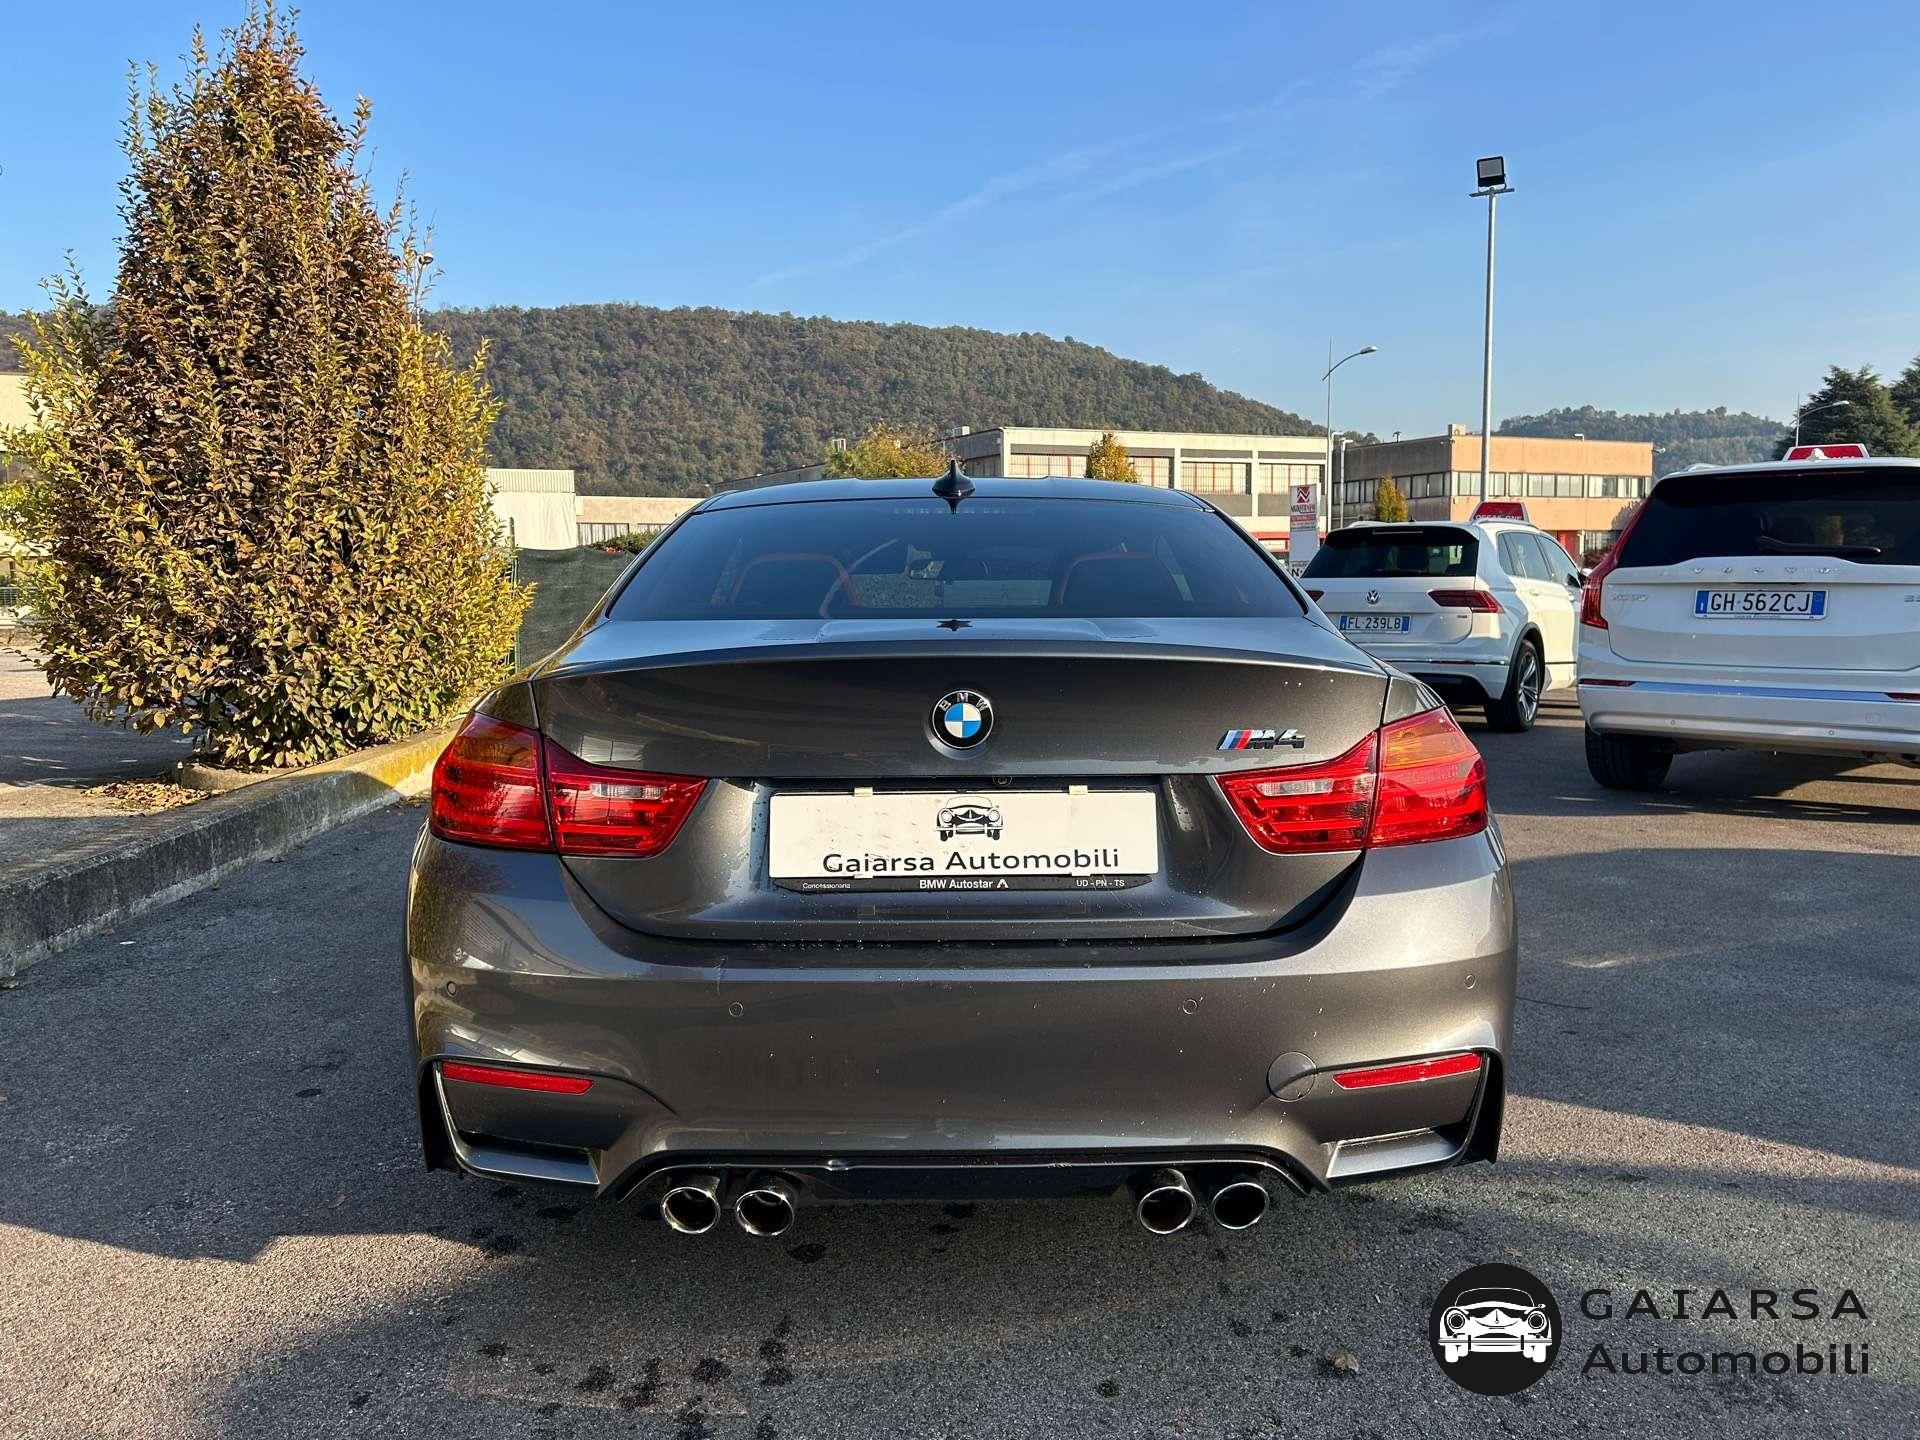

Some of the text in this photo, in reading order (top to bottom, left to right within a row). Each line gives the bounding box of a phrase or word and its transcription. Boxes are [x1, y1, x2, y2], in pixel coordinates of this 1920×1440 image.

[1742, 593, 1811, 612] 562CJ
[938, 691, 989, 712] BMW
[1247, 728, 1306, 750] M4
[823, 849, 1120, 874] Gaiarsa Automobili
[919, 879, 993, 889] BMW Autostar
[1076, 879, 1089, 887] UD
[1095, 879, 1107, 887] PN
[1114, 879, 1125, 887] TS
